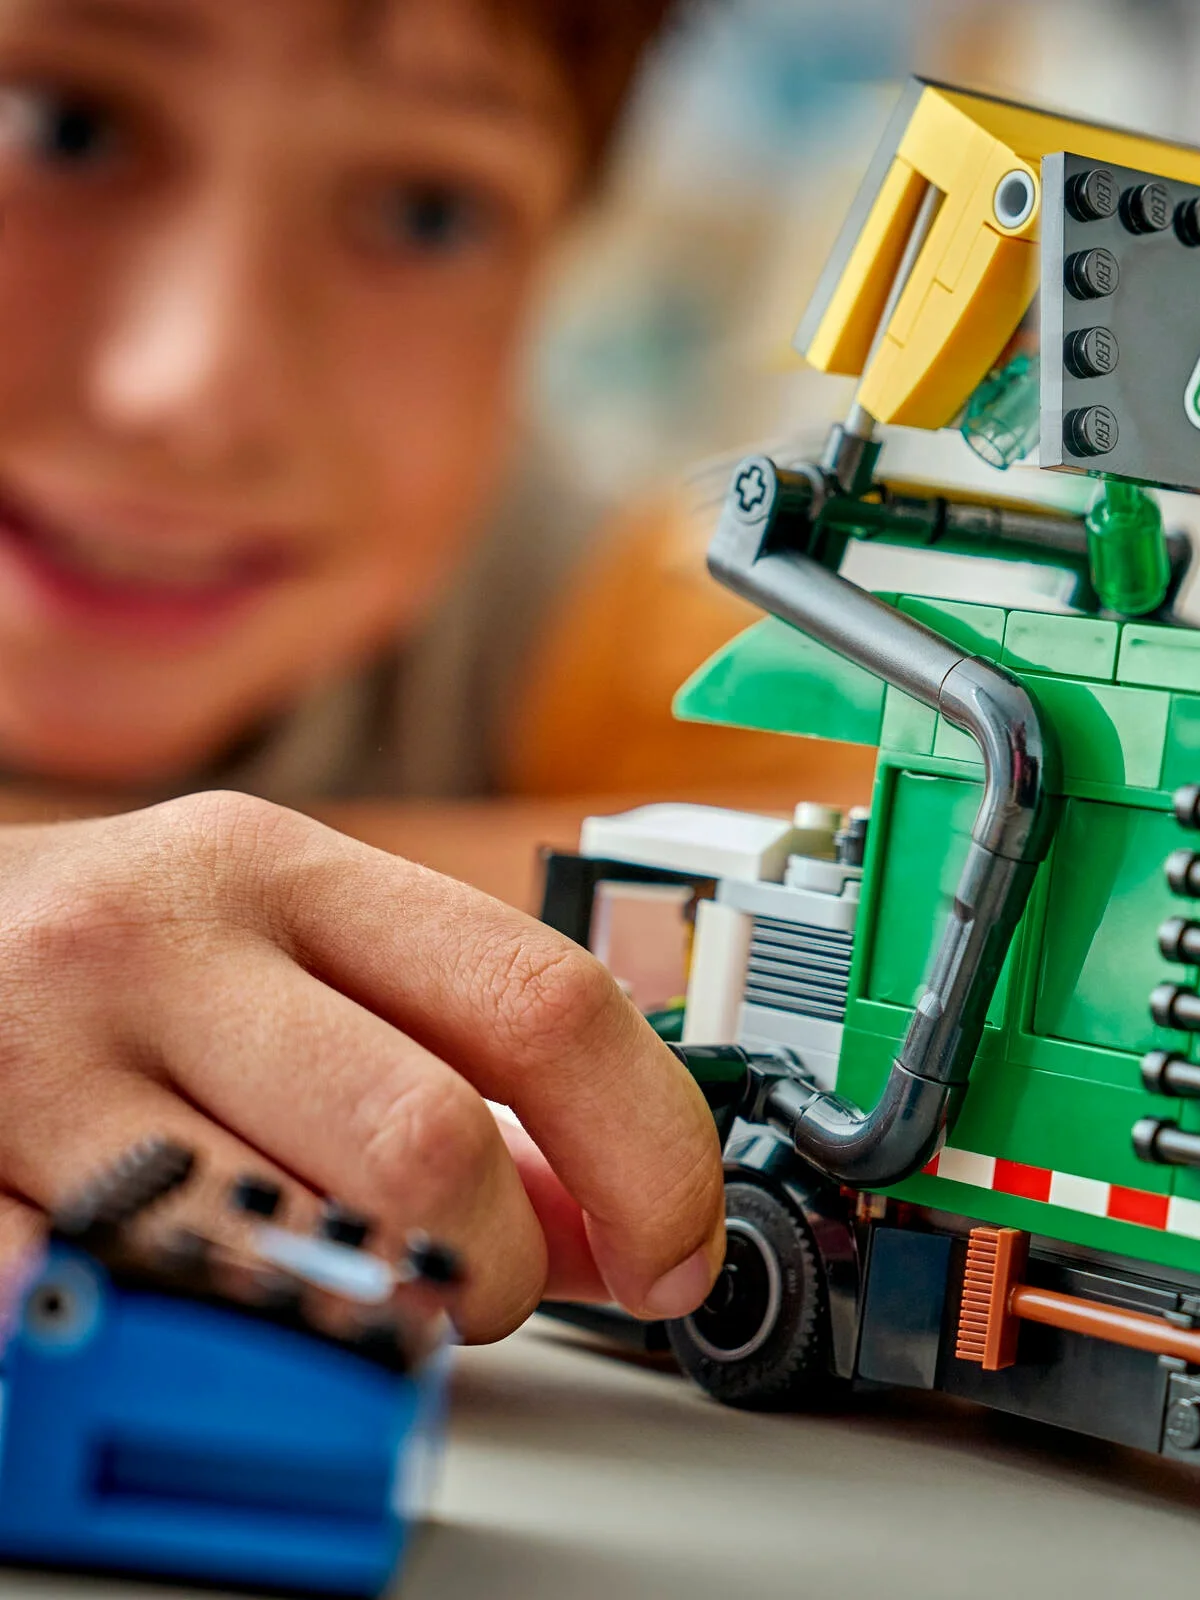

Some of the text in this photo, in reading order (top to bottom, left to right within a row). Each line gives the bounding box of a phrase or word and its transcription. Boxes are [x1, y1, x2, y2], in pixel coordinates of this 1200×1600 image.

[1095, 173, 1113, 213] LEGO
[1151, 186, 1168, 226] LEGO
[1094, 252, 1112, 291] LEGO
[1095, 330, 1111, 370] LEGO
[1094, 409, 1110, 449] LEGO
